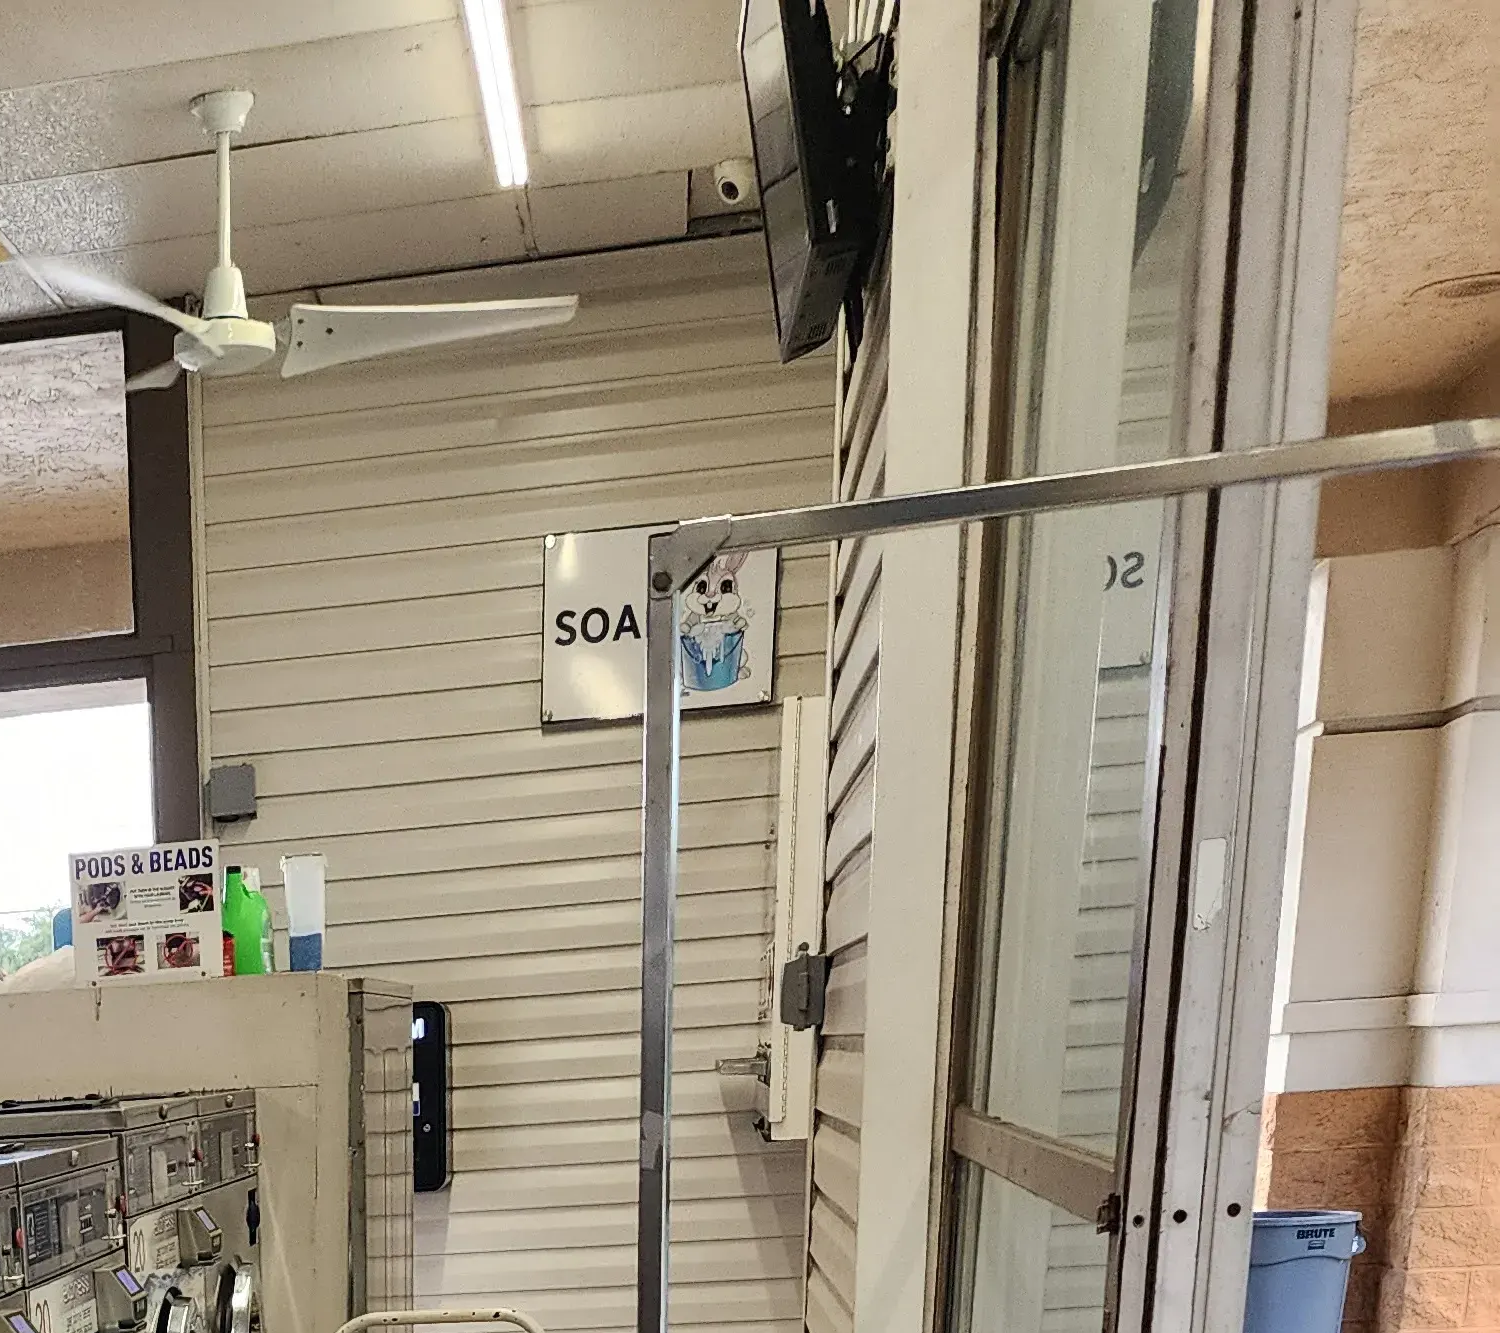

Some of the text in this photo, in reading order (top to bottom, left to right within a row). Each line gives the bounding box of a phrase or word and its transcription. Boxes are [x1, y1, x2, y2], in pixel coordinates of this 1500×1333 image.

[555, 604, 642, 646] SOA
[75, 845, 213, 880] PODS & BEADS
[1297, 1228, 1336, 1239] BRUTE
